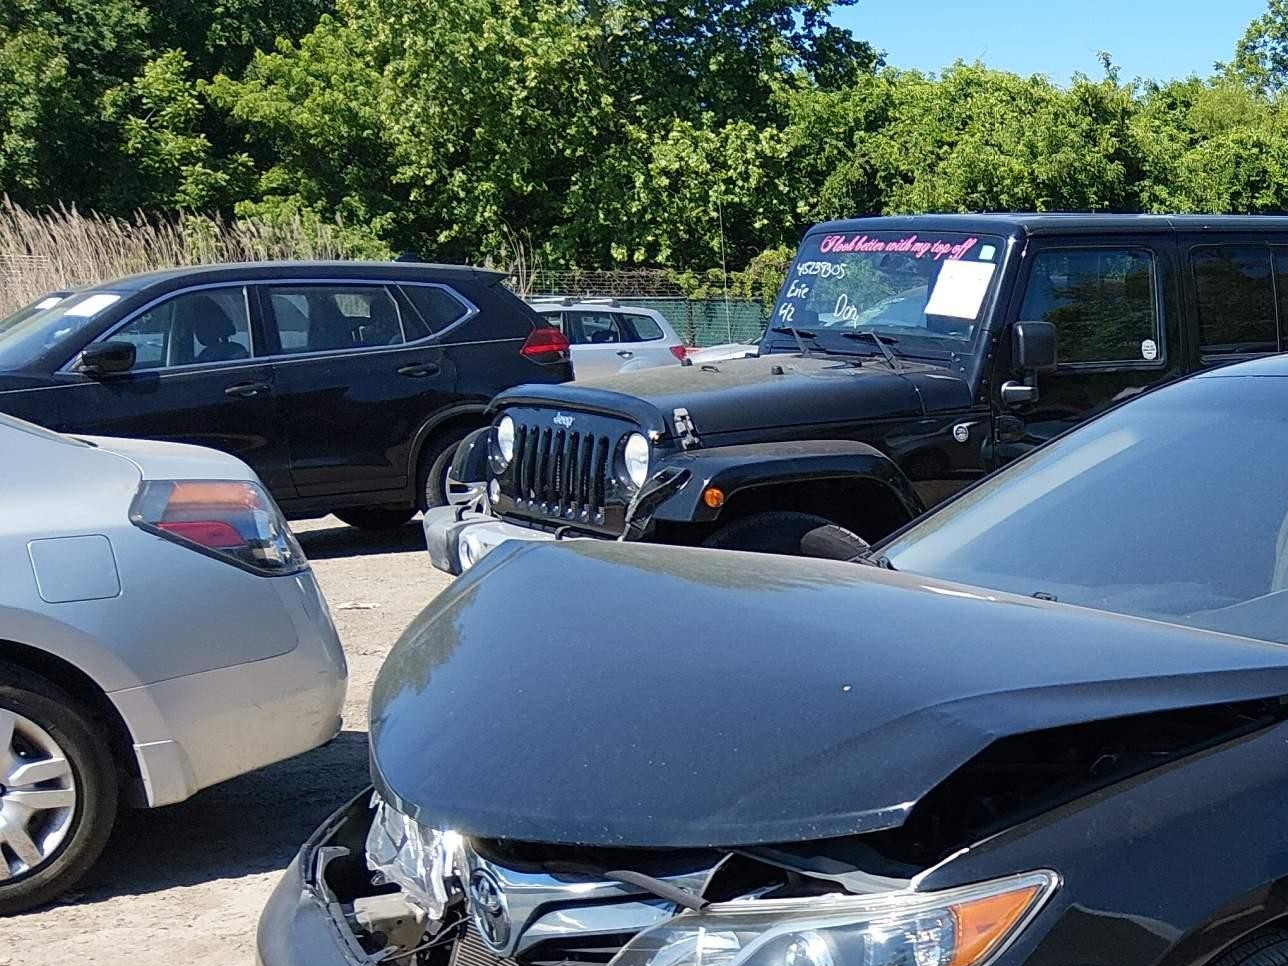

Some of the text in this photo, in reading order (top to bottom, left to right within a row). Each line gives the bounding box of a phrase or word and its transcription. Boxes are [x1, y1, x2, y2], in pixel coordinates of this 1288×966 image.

[855, 236, 886, 252] better
[885, 235, 917, 252] with
[911, 241, 932, 258] my
[931, 240, 952, 260] top
[949, 238, 977, 260] off
